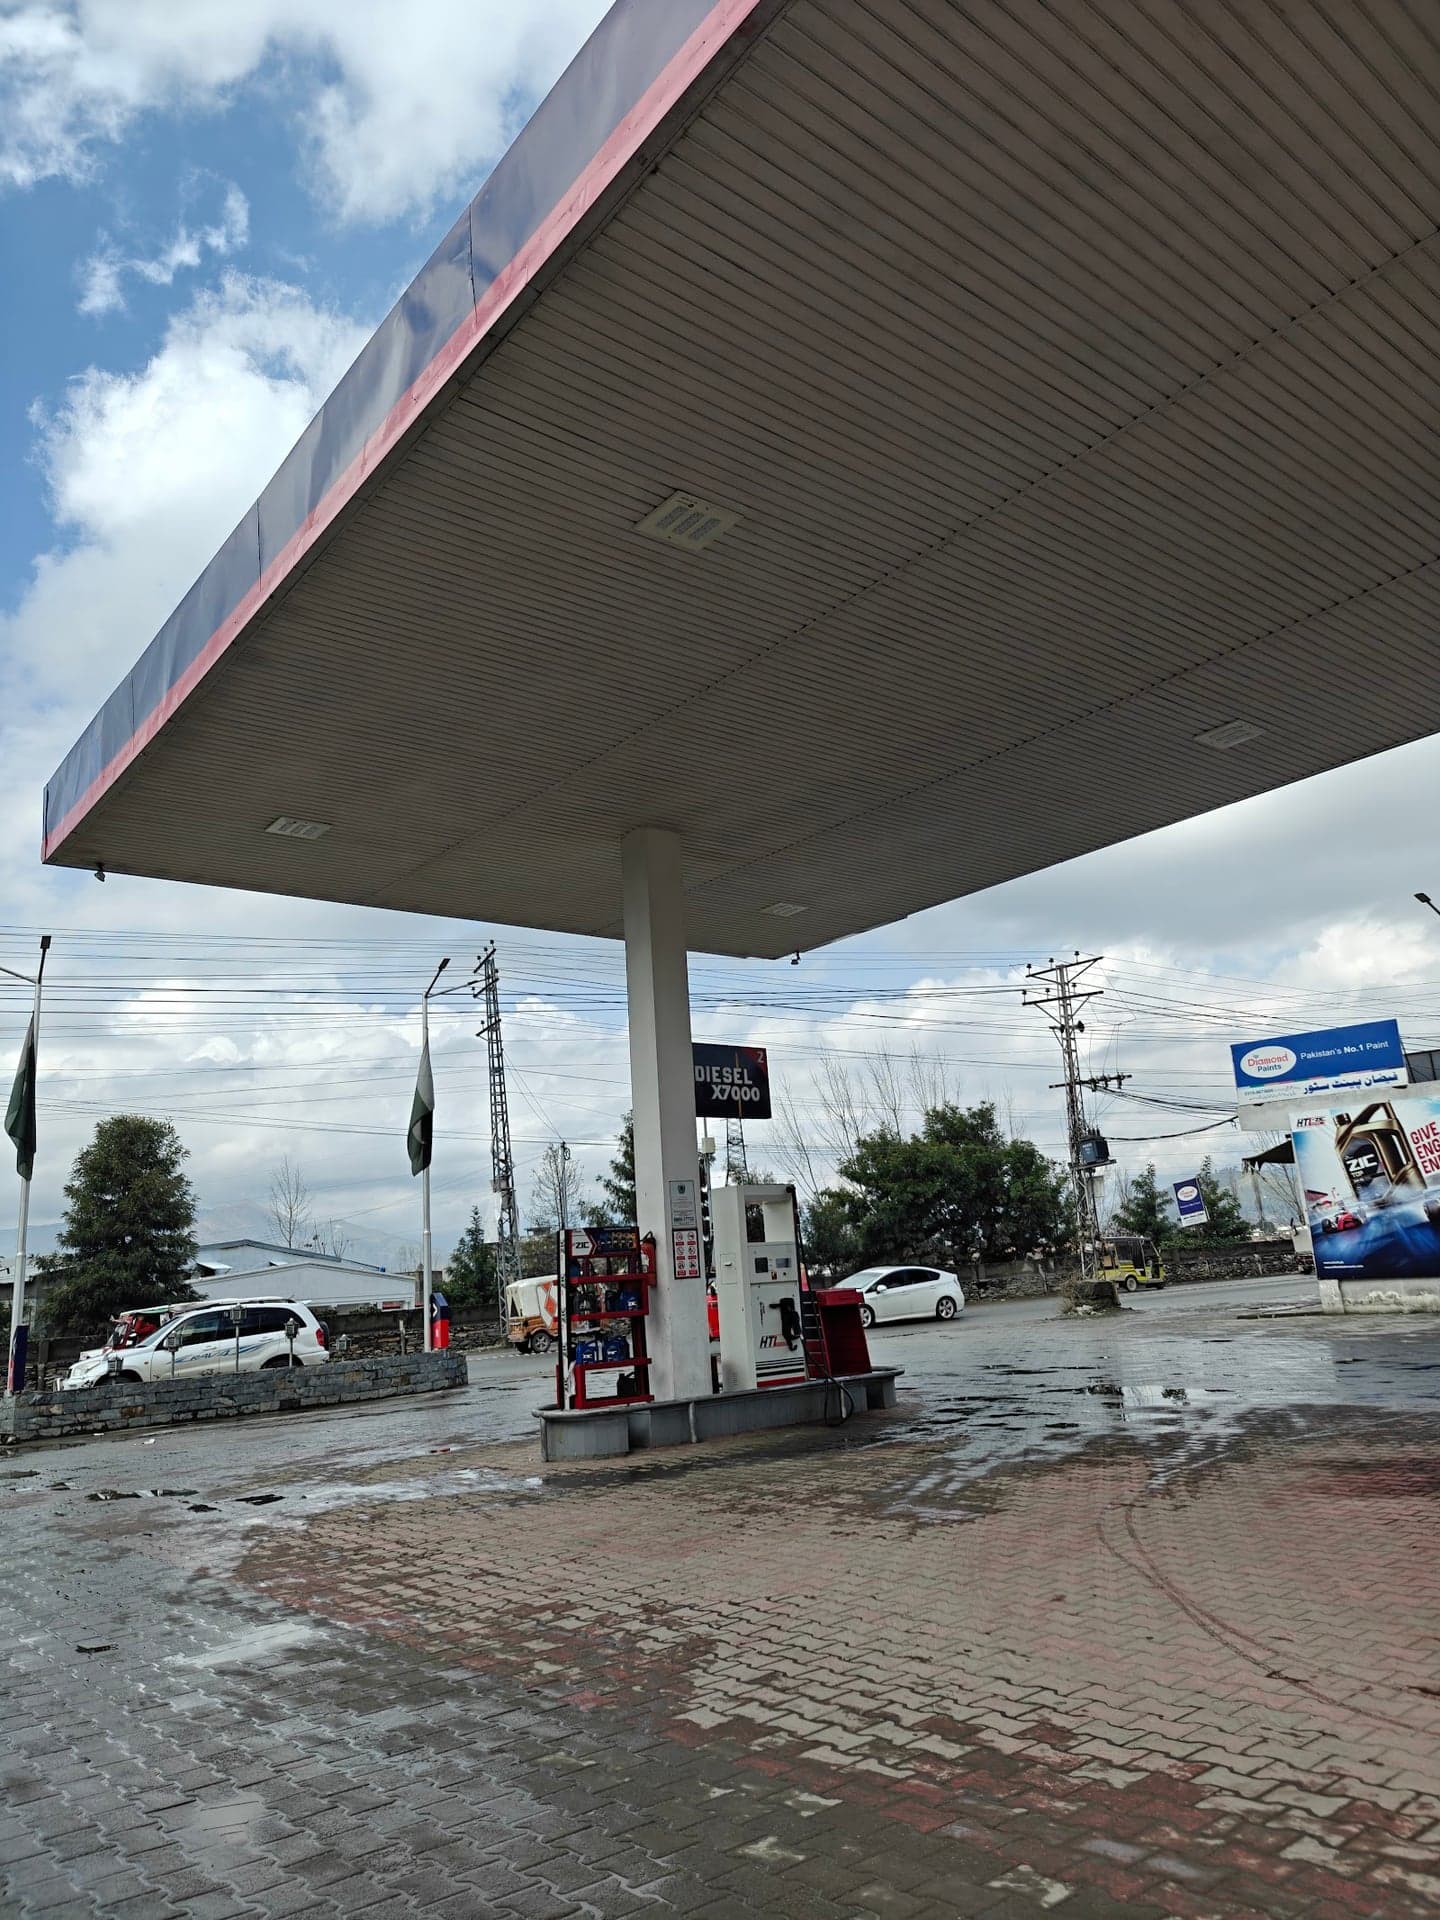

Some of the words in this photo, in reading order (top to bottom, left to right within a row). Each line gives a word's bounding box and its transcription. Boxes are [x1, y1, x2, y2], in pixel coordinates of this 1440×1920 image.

[1300, 1048, 1342, 1060] Pakistan's
[1343, 1044, 1364, 1054] No.1
[1366, 1041, 1389, 1051] Paint
[1247, 1053, 1289, 1067] Diamond
[1257, 1064, 1282, 1073] Paints
[695, 1065, 753, 1085] DIESEL
[712, 1084, 760, 1102] X7000
[1410, 1121, 1440, 1145] GIVE
[1345, 1153, 1378, 1172] ZIC
[575, 1241, 590, 1249] ZIC
